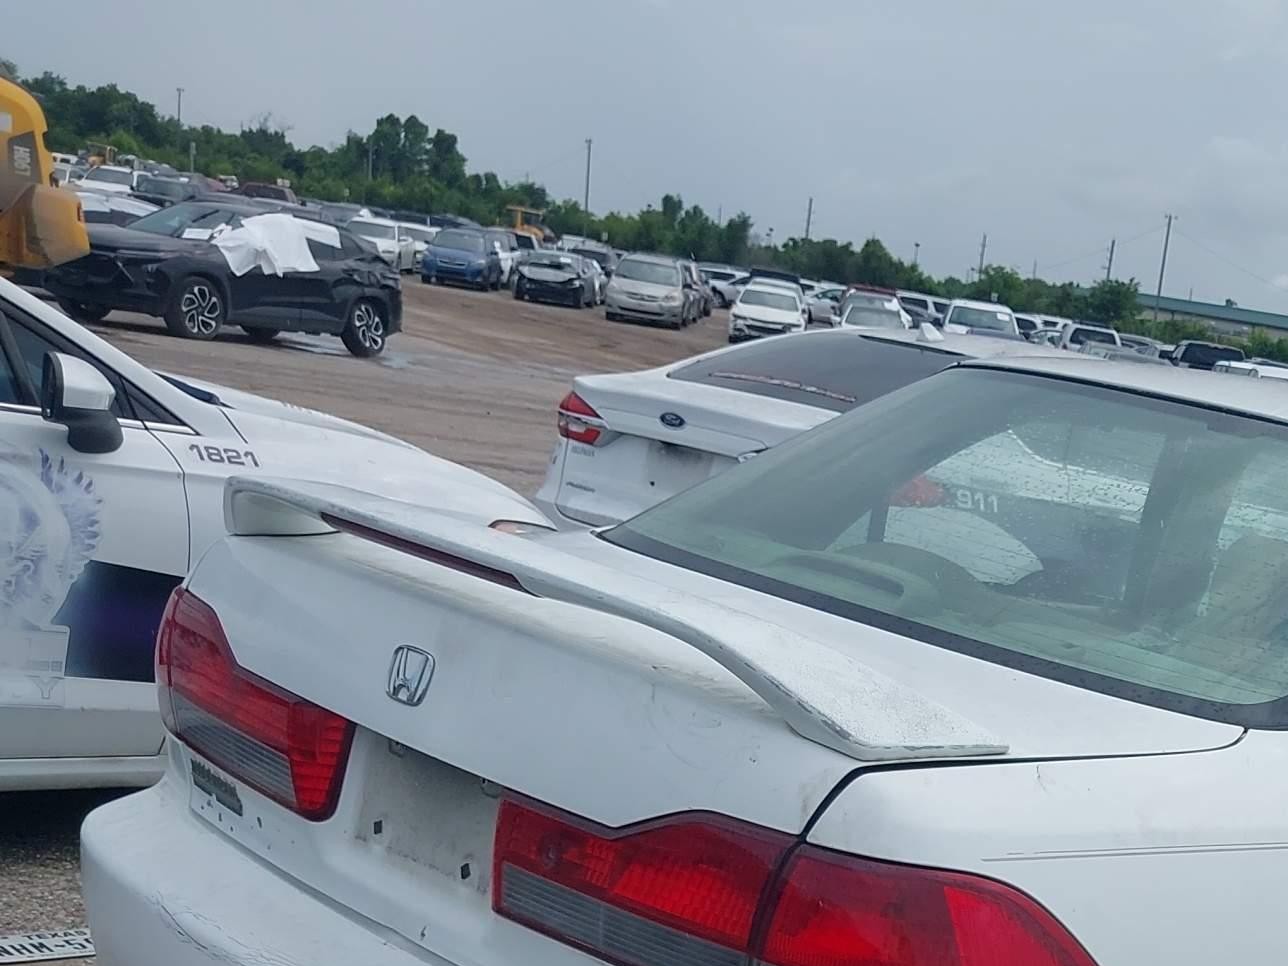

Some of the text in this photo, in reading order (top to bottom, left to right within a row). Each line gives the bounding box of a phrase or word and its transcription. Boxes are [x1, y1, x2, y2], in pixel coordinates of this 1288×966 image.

[189, 443, 260, 468] 1821
[956, 488, 999, 513] 911
[21, 930, 88, 940] TEXAS
